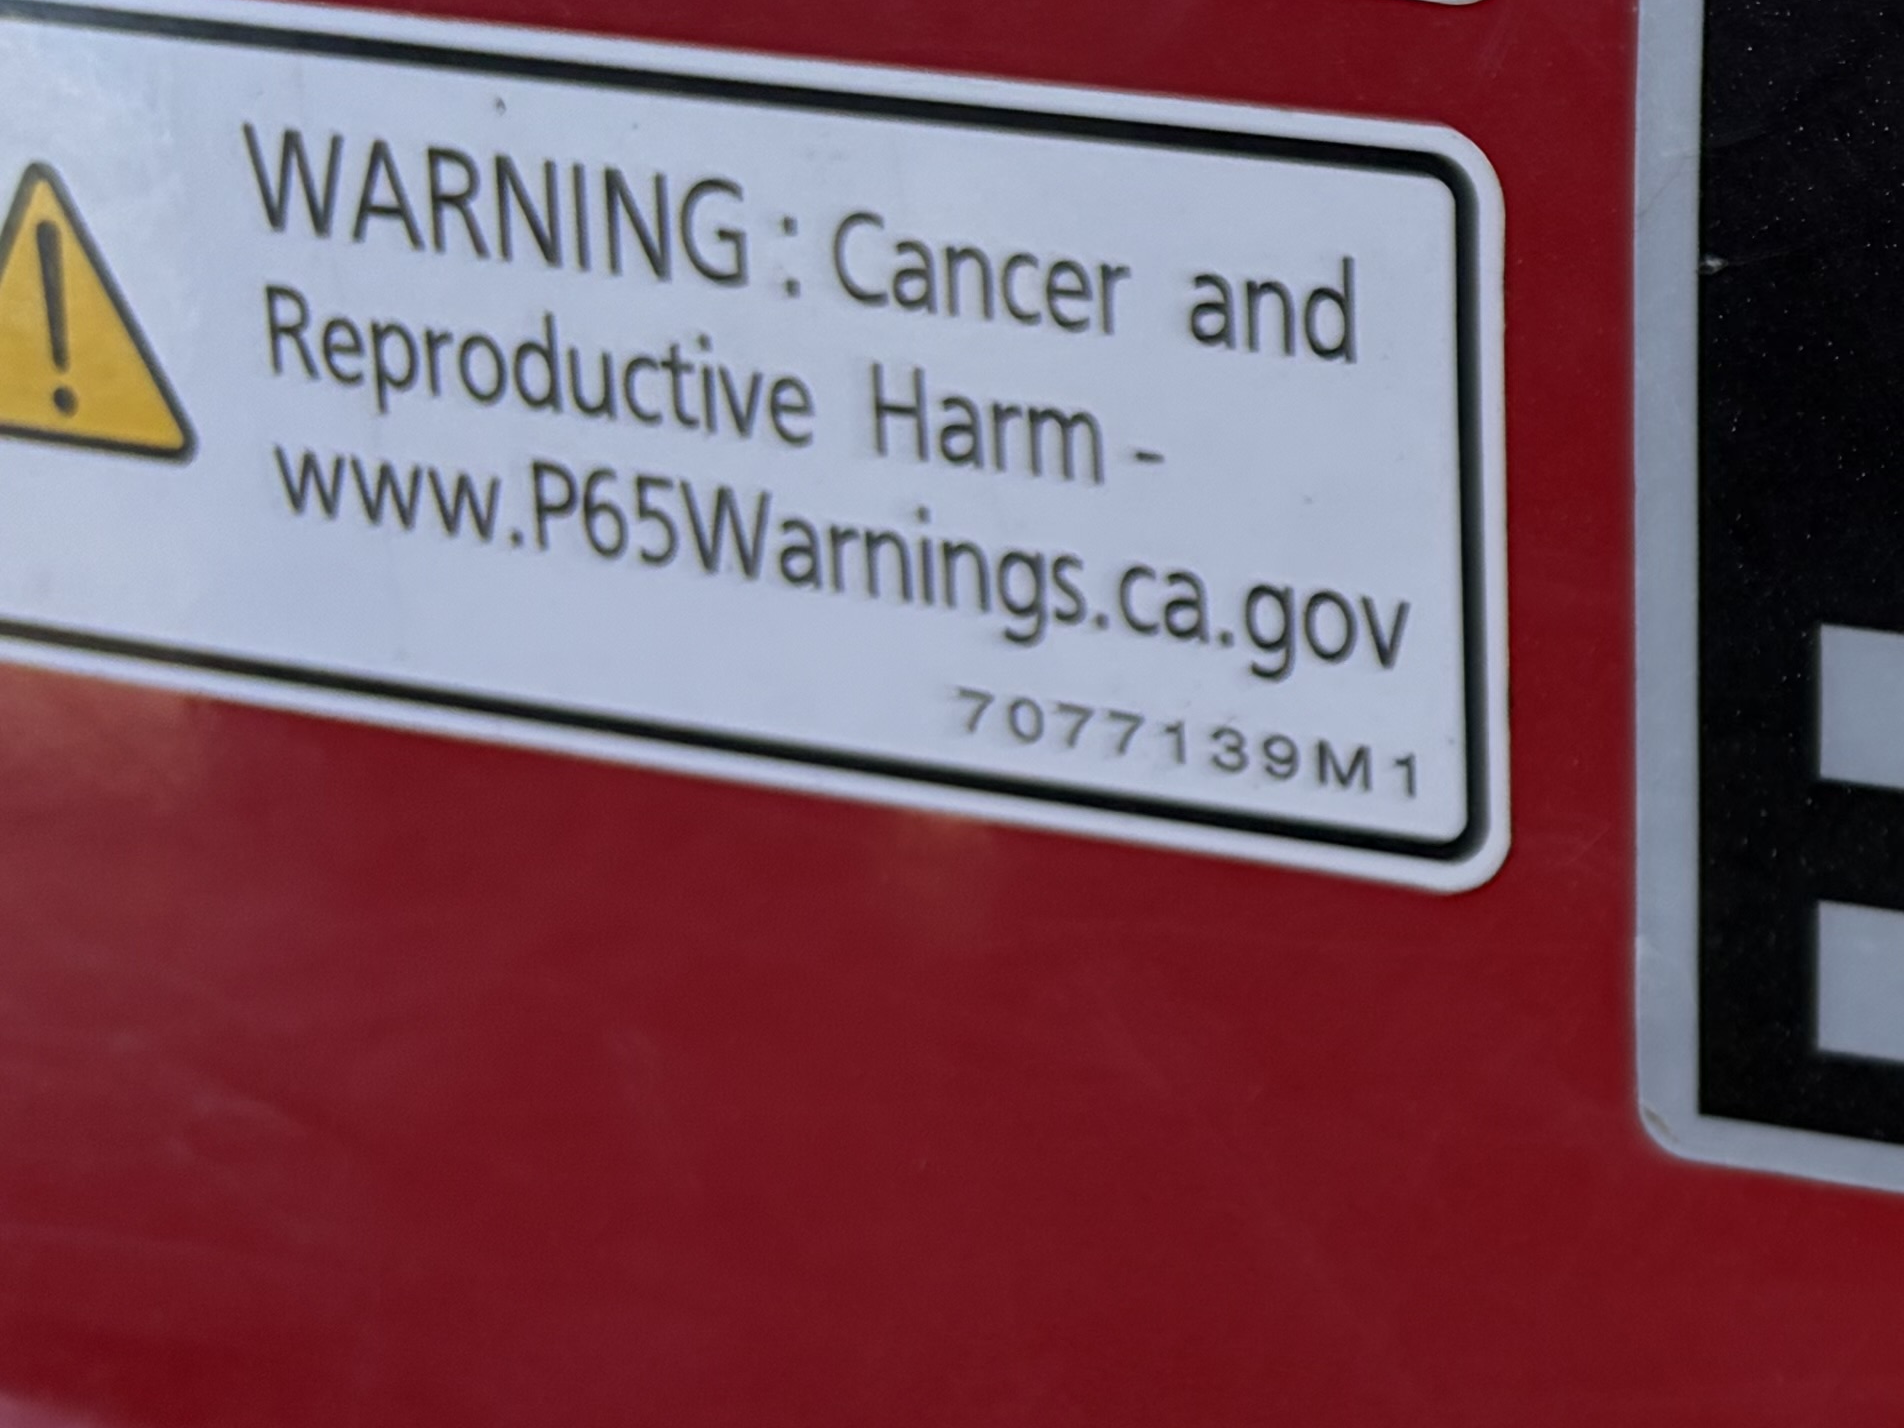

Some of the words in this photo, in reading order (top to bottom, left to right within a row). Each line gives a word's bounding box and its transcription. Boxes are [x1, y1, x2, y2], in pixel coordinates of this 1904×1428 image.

[832, 212, 1130, 336] Cancer
[1188, 259, 1357, 363] and
[266, 287, 814, 445] Reproductive
[871, 365, 1106, 486] Harm
[276, 444, 1409, 680] www.P65Warnings.ca.gov
[956, 688, 1419, 799] 7077139M1
